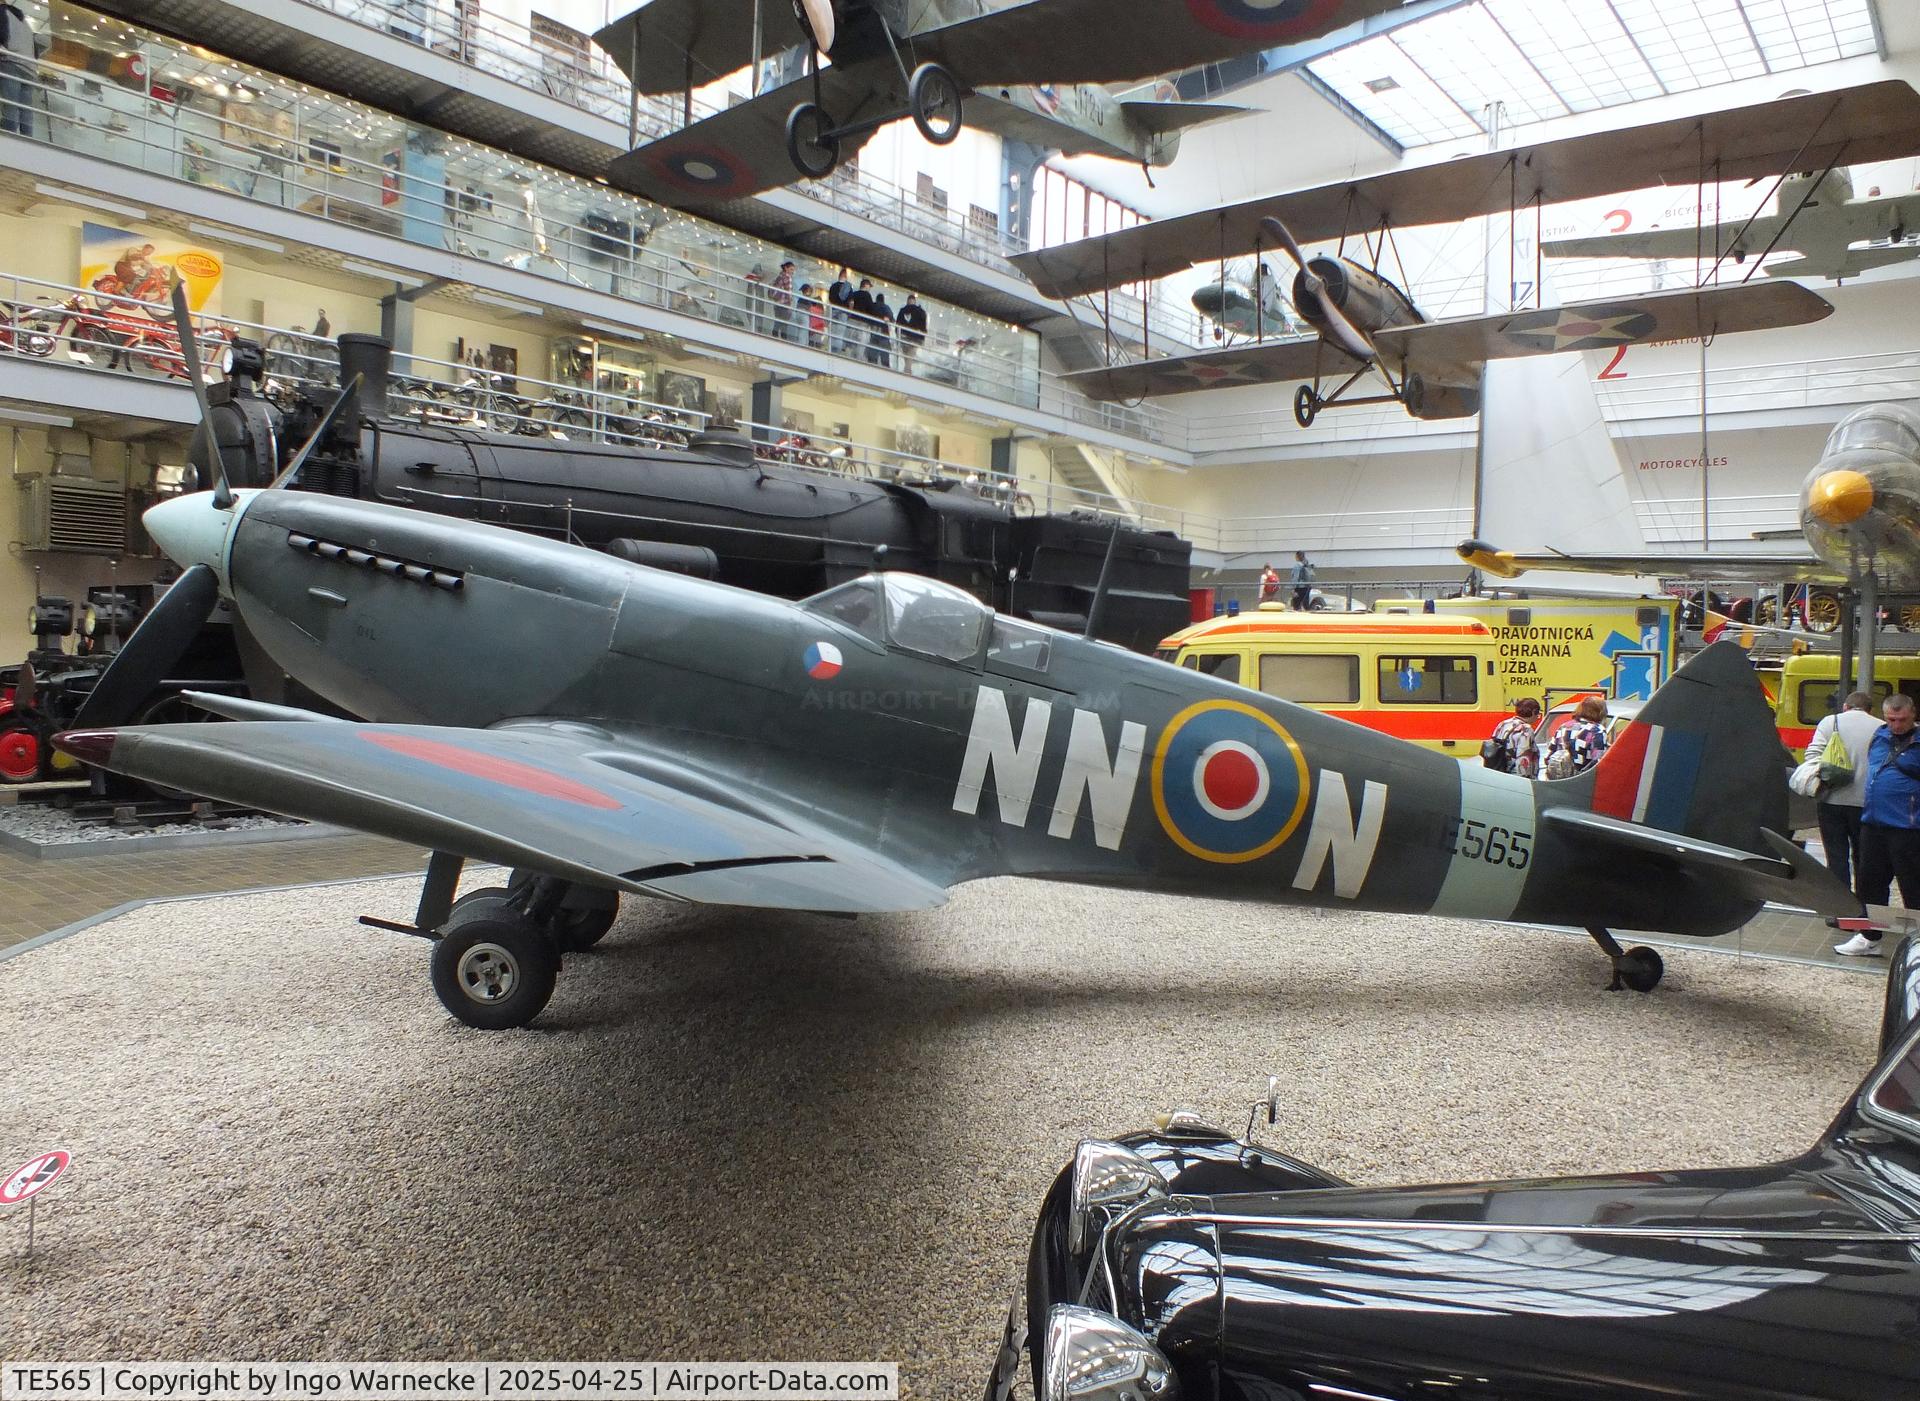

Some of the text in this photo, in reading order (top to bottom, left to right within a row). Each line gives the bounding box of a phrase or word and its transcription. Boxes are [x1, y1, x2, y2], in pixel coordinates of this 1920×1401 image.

[1665, 201, 1720, 218] BICYCLE
[1540, 224, 1577, 238] ISTIKA
[1597, 344, 1628, 380] 2
[1639, 456, 1729, 471] MOTORCYCLES
[1489, 623, 1594, 641] DRAVOTNICKÁ
[1499, 640, 1572, 658] CHRANNÁ
[1499, 657, 1537, 674] UŽBA
[1510, 676, 1543, 687] PRAHY
[1292, 768, 1388, 899] N
